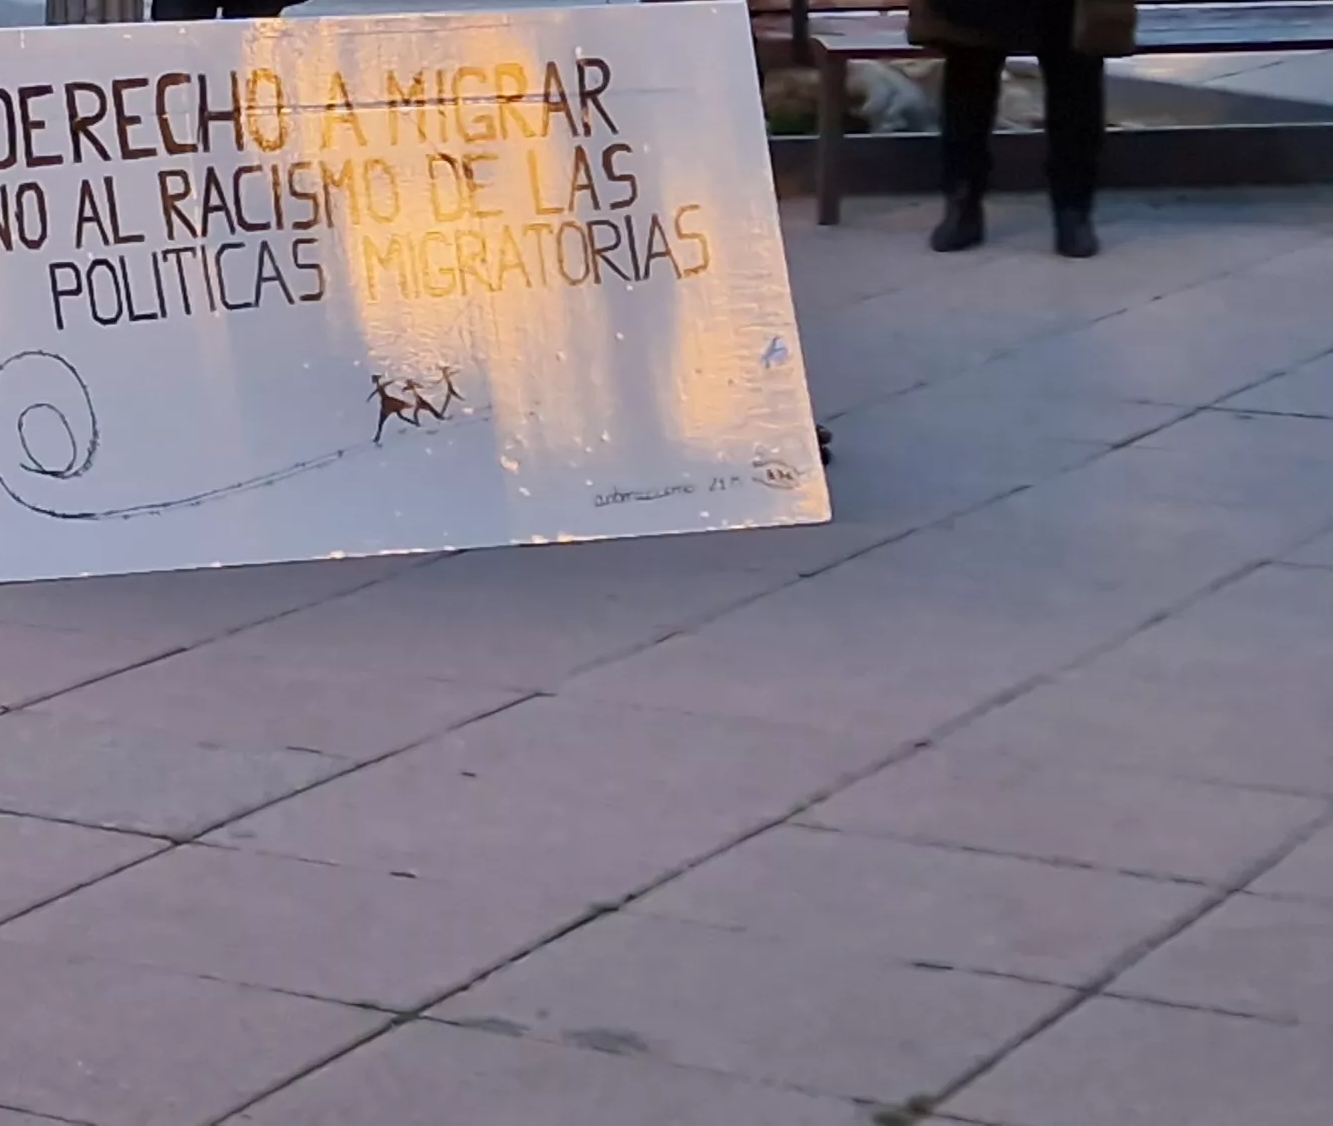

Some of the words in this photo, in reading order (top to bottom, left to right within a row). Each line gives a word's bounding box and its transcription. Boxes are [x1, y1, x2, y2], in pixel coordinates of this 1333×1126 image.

[320, 71, 368, 150] A
[386, 58, 619, 146] MIGRAR
[75, 176, 145, 249] AL
[158, 157, 400, 240] RACISMO
[428, 152, 503, 222] DE
[526, 143, 638, 215] LAS
[49, 238, 325, 330] POLITICAS
[362, 204, 710, 303] MIGRATORIAS
